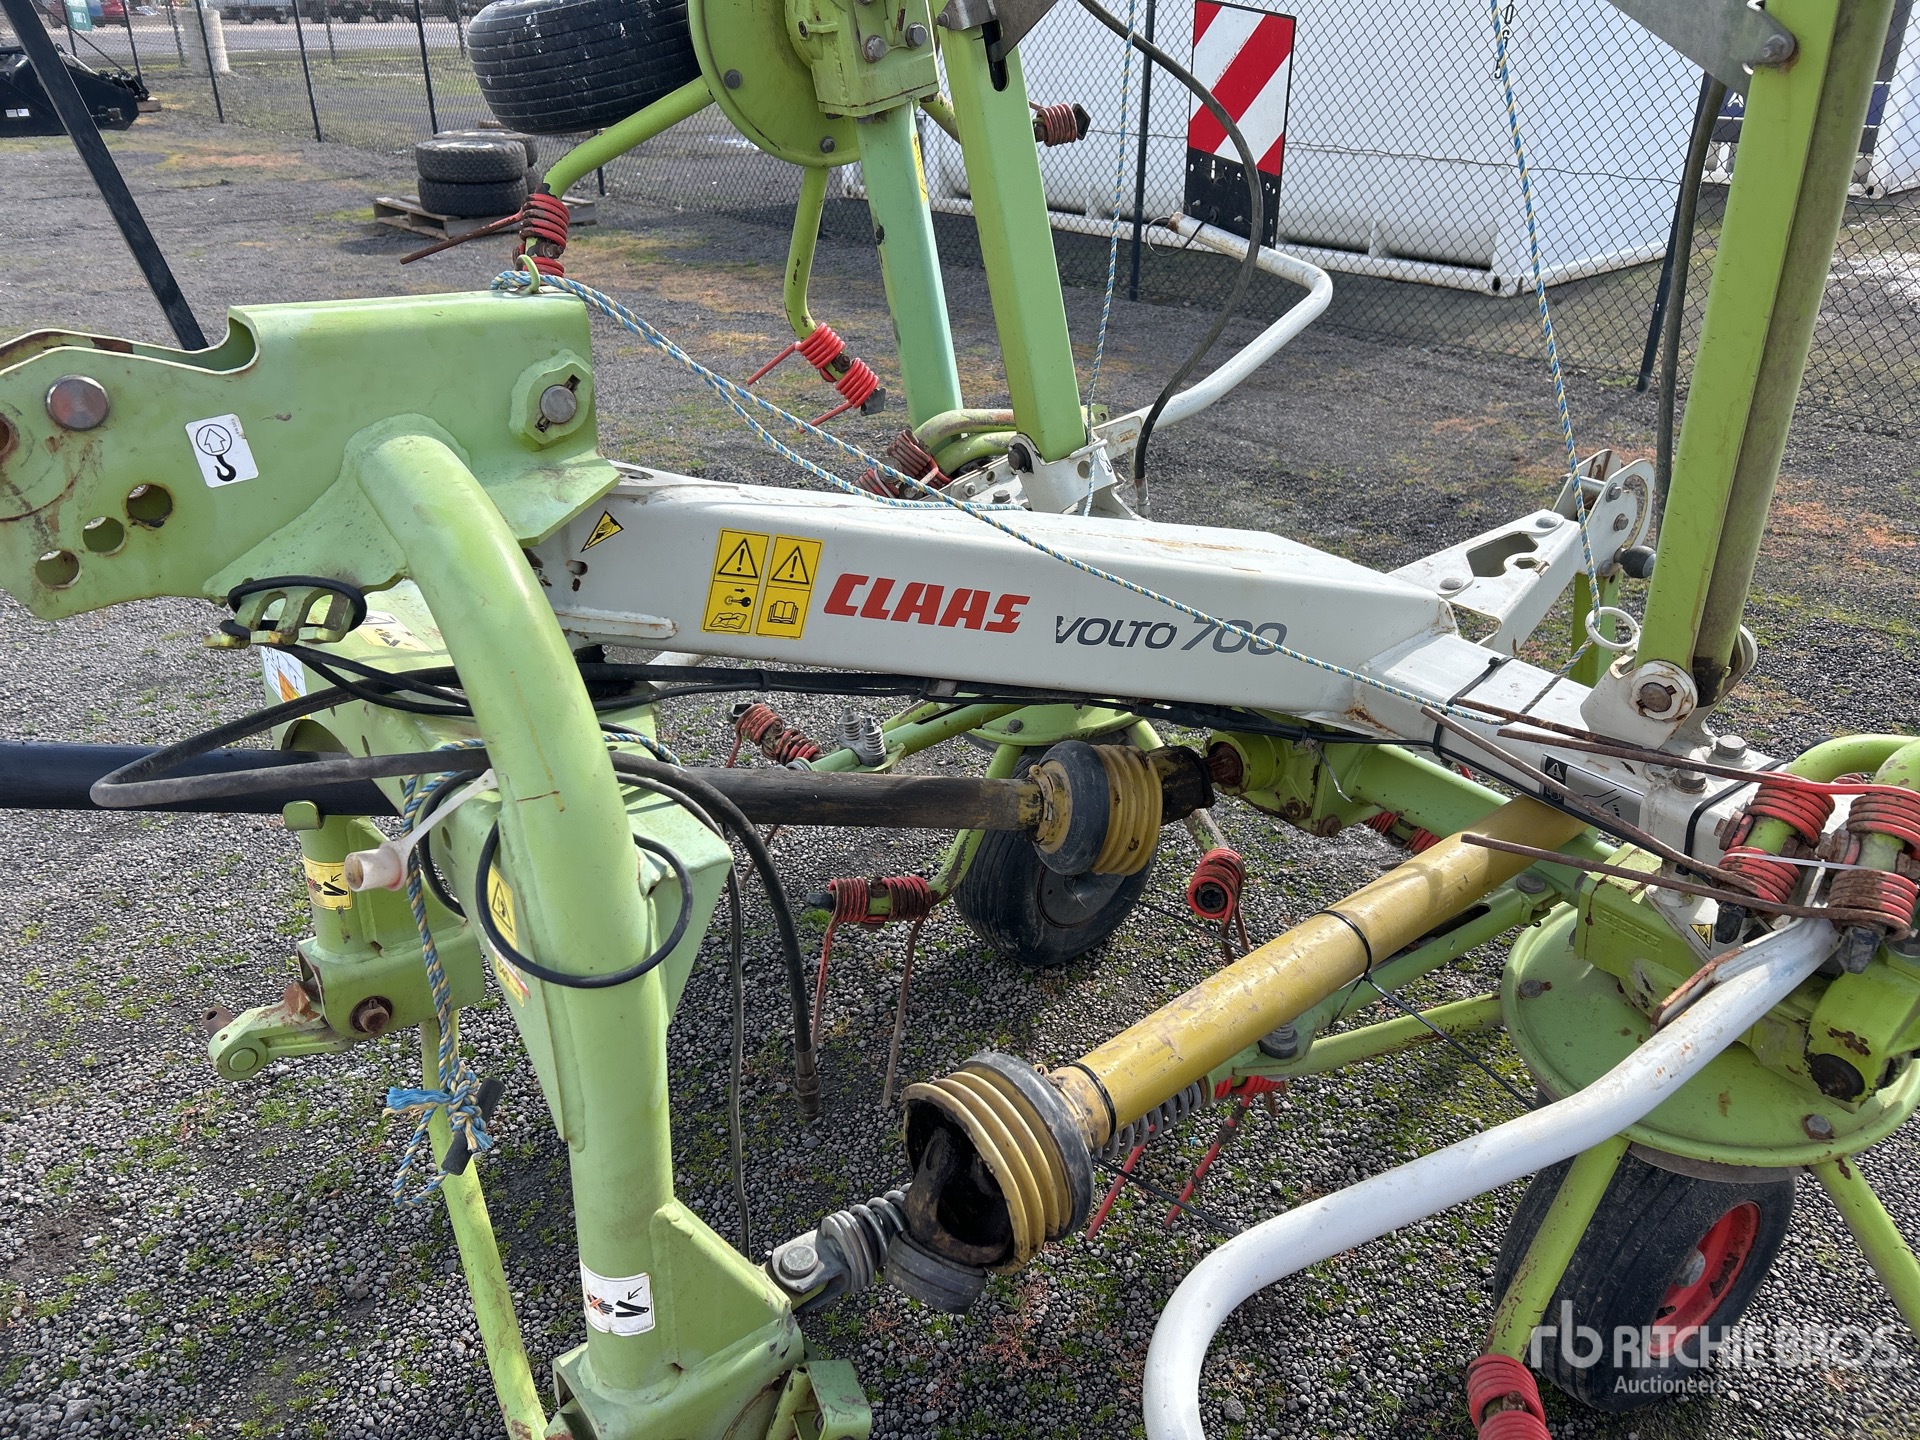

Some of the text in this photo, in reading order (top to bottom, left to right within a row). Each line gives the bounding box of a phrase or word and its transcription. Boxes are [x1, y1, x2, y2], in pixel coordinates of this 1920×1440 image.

[824, 573, 1288, 656] CLAAS VOLTO 700
